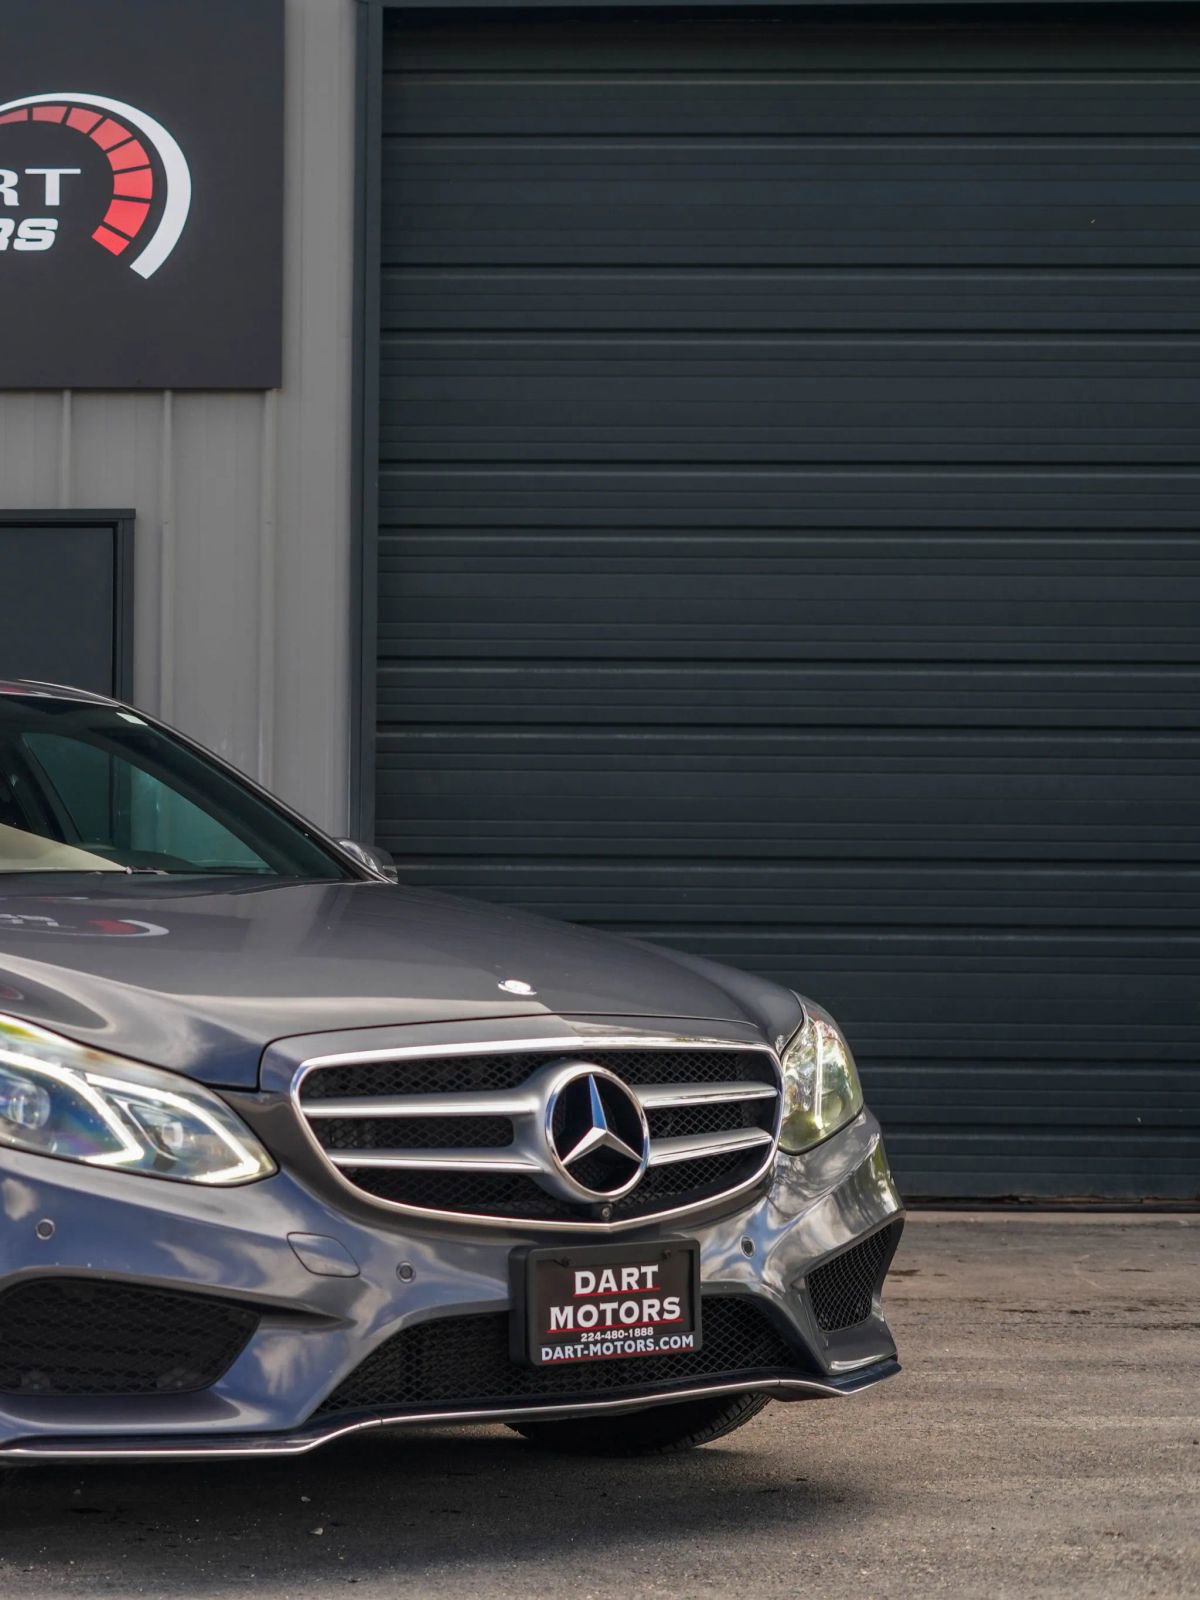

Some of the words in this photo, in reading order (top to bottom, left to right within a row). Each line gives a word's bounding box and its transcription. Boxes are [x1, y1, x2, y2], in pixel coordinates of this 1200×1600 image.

[574, 1264, 659, 1295] DART
[550, 1297, 681, 1331] MOTORS
[541, 1335, 694, 1361] DART-MOTORS.COM
[580, 1326, 654, 1342] 224-480-1888
